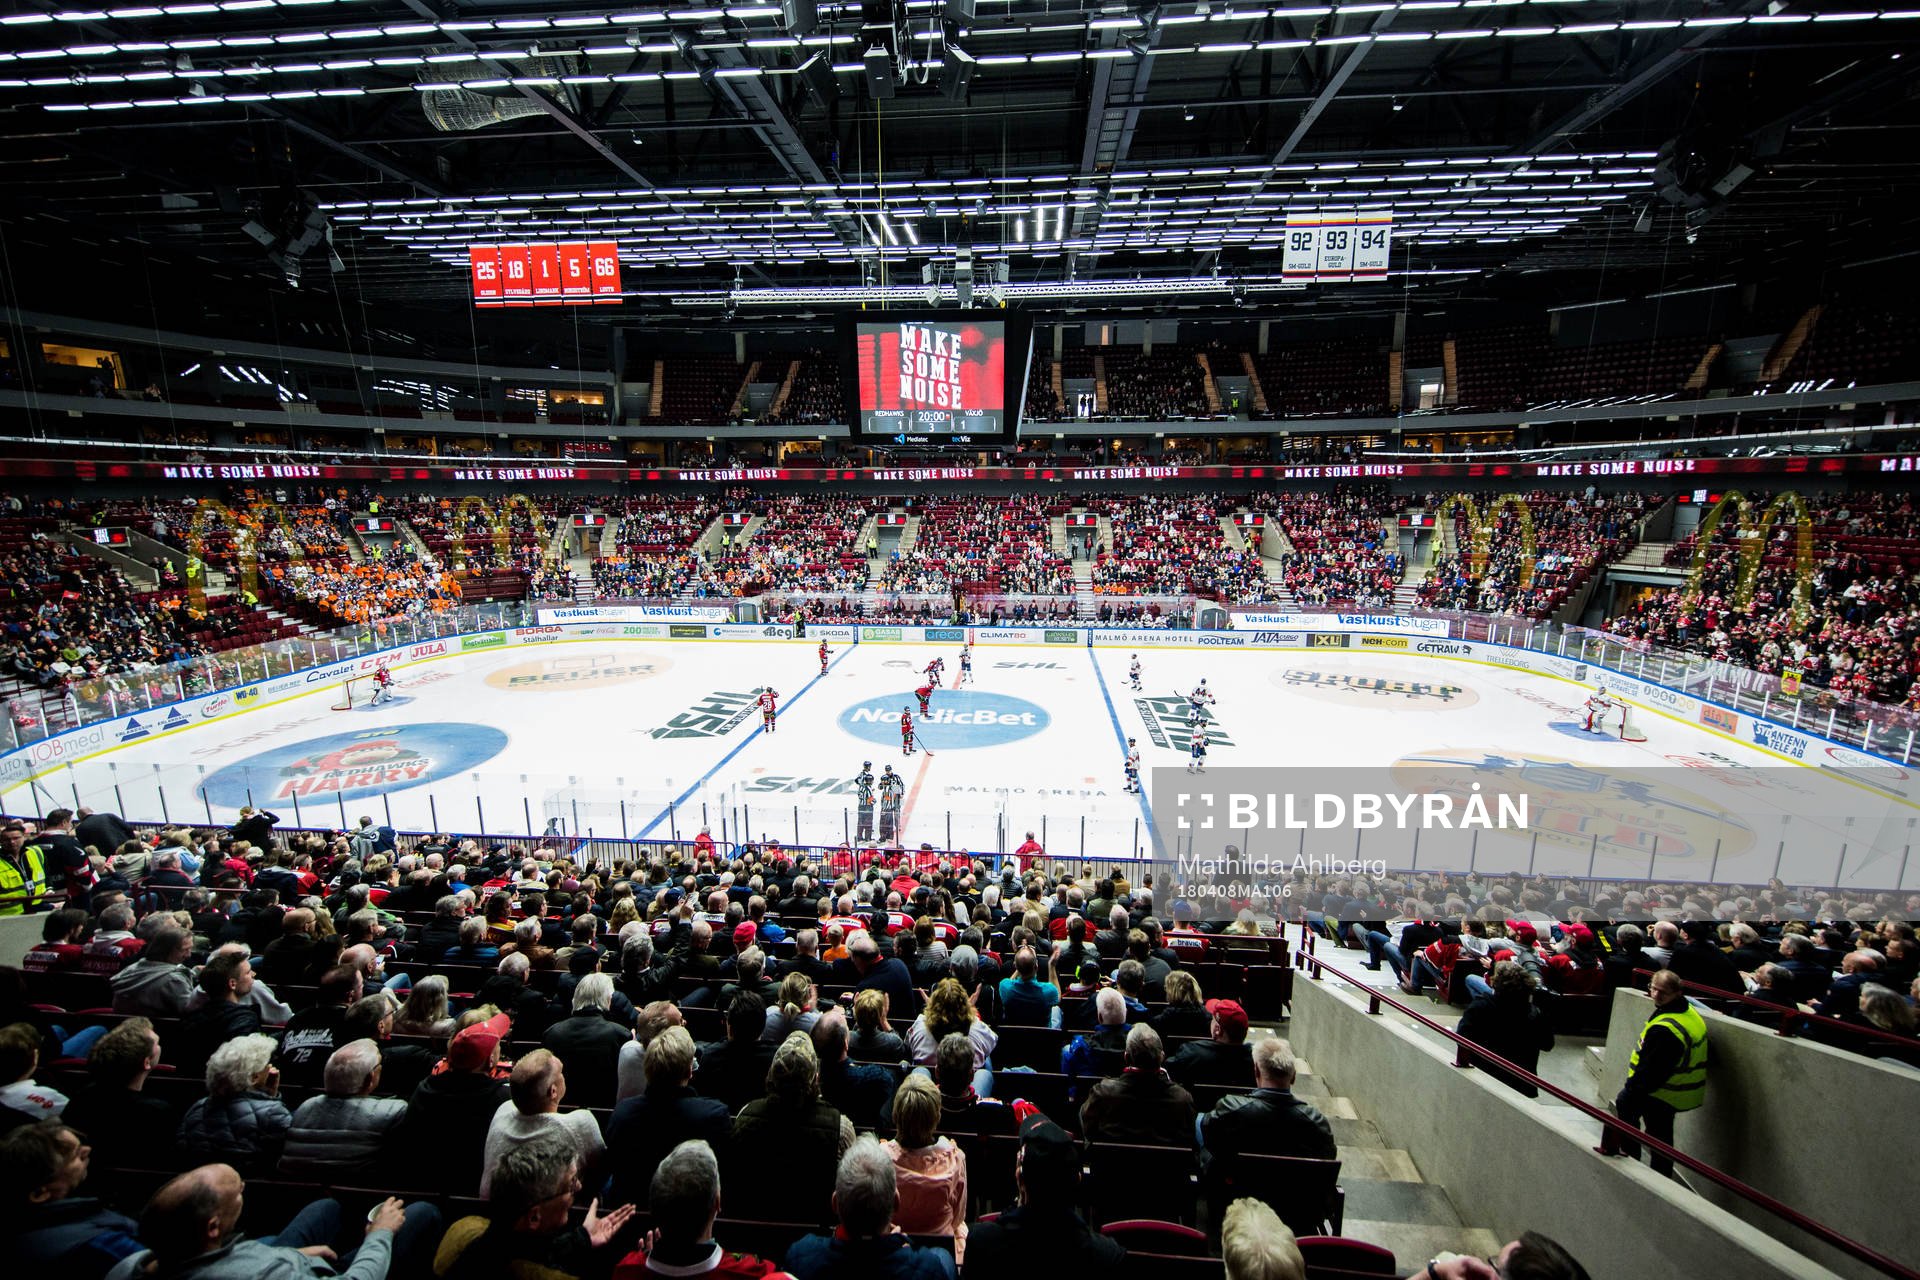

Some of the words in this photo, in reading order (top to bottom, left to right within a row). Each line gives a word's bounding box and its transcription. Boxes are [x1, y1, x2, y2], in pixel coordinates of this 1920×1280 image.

[1291, 231, 1313, 251] 92
[1326, 230, 1348, 250] 93
[1361, 229, 1386, 249] 94
[476, 261, 497, 280] 25
[507, 260, 524, 279] 18
[541, 259, 549, 278] 1
[569, 258, 580, 278] 5
[594, 257, 616, 277] 66
[900, 323, 962, 360] MAKE
[902, 349, 960, 385] SOME
[900, 374, 963, 410] NOISE
[918, 411, 946, 422] 20:00
[898, 421, 903, 430] 1
[928, 422, 935, 432] 3
[960, 421, 966, 430] 1
[164, 466, 215, 479] MAKE
[221, 465, 267, 479] SOME
[272, 465, 321, 478] NOISE
[455, 469, 494, 481] MAKE
[499, 469, 533, 480] SOME
[538, 468, 575, 480] NOISE
[679, 470, 711, 481] MAKE
[714, 470, 743, 481] SOME
[747, 469, 778, 480] NOISE
[873, 470, 905, 481] MAKE
[908, 469, 937, 480] SOME
[942, 468, 974, 479] NOISE
[1074, 470, 1105, 480] MAKE
[1110, 469, 1140, 480] SOME
[1146, 467, 1179, 478] NOISE
[1285, 468, 1320, 479] MAKE
[1325, 466, 1360, 478] SOME
[1365, 464, 1403, 476] NOISE
[1537, 465, 1583, 476] MAKE
[1589, 462, 1635, 475] SOME
[1643, 459, 1695, 473] NOISE
[515, 626, 563, 636] BORGA
[623, 626, 642, 635] 200
[926, 631, 963, 640] areco
[1095, 633, 1128, 642] MALMÖ
[1131, 634, 1161, 642] ARENA
[1165, 635, 1194, 643] HOTEL
[522, 634, 559, 644] Stålhallar
[1198, 637, 1245, 646] POOLTEAM
[412, 642, 446, 659] JULA
[1416, 643, 1460, 655] GETRAW
[360, 651, 403, 670] CCM
[235, 687, 258, 701] WD-40
[762, 700, 773, 711] 28
[1770, 730, 1808, 750] ANTENN
[1769, 739, 1789, 754] TELE
[1790, 747, 1804, 759] AB
[277, 764, 430, 800] HARRY
[292, 1047, 313, 1063] 72
